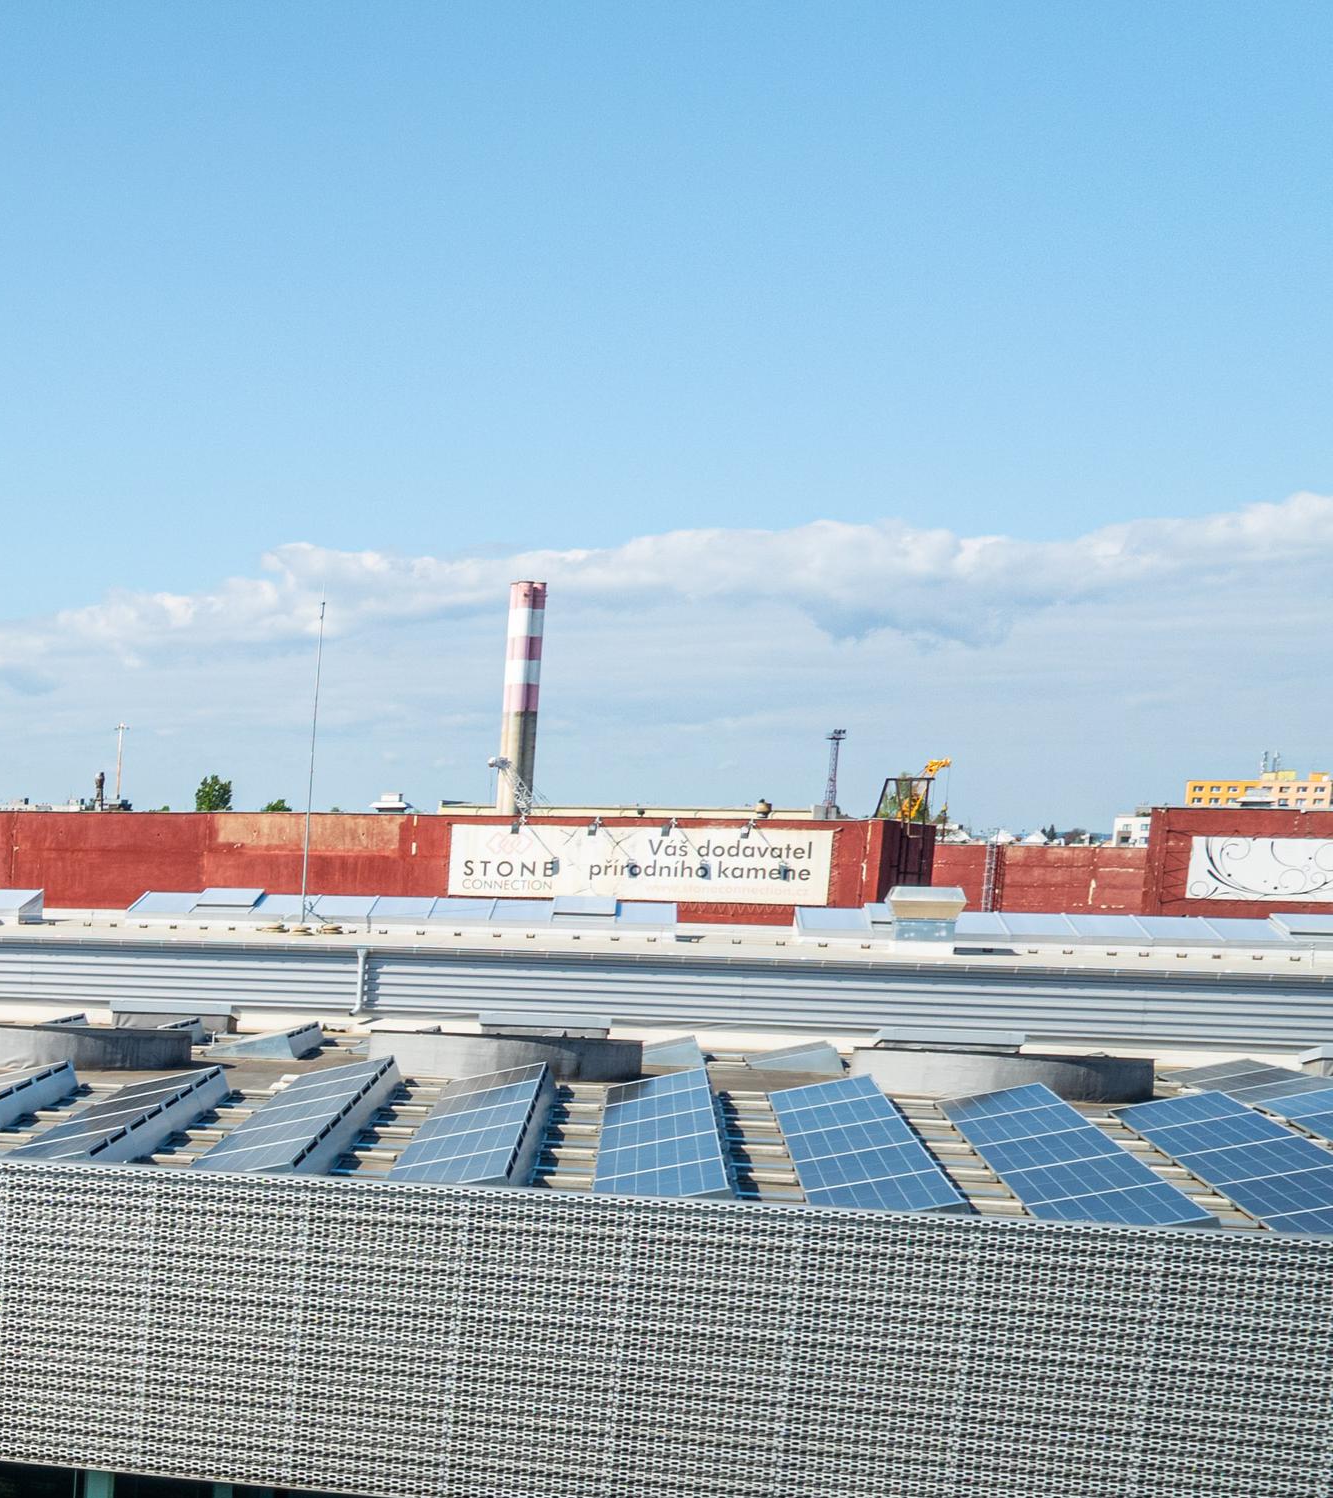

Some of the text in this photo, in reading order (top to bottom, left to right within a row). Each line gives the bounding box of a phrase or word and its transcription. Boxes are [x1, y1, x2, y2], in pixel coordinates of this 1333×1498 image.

[648, 838, 813, 859] Váš dodavatel
[463, 859, 554, 878] STONE
[588, 859, 811, 881] přírodního kamene
[462, 878, 553, 891] CONNECTION
